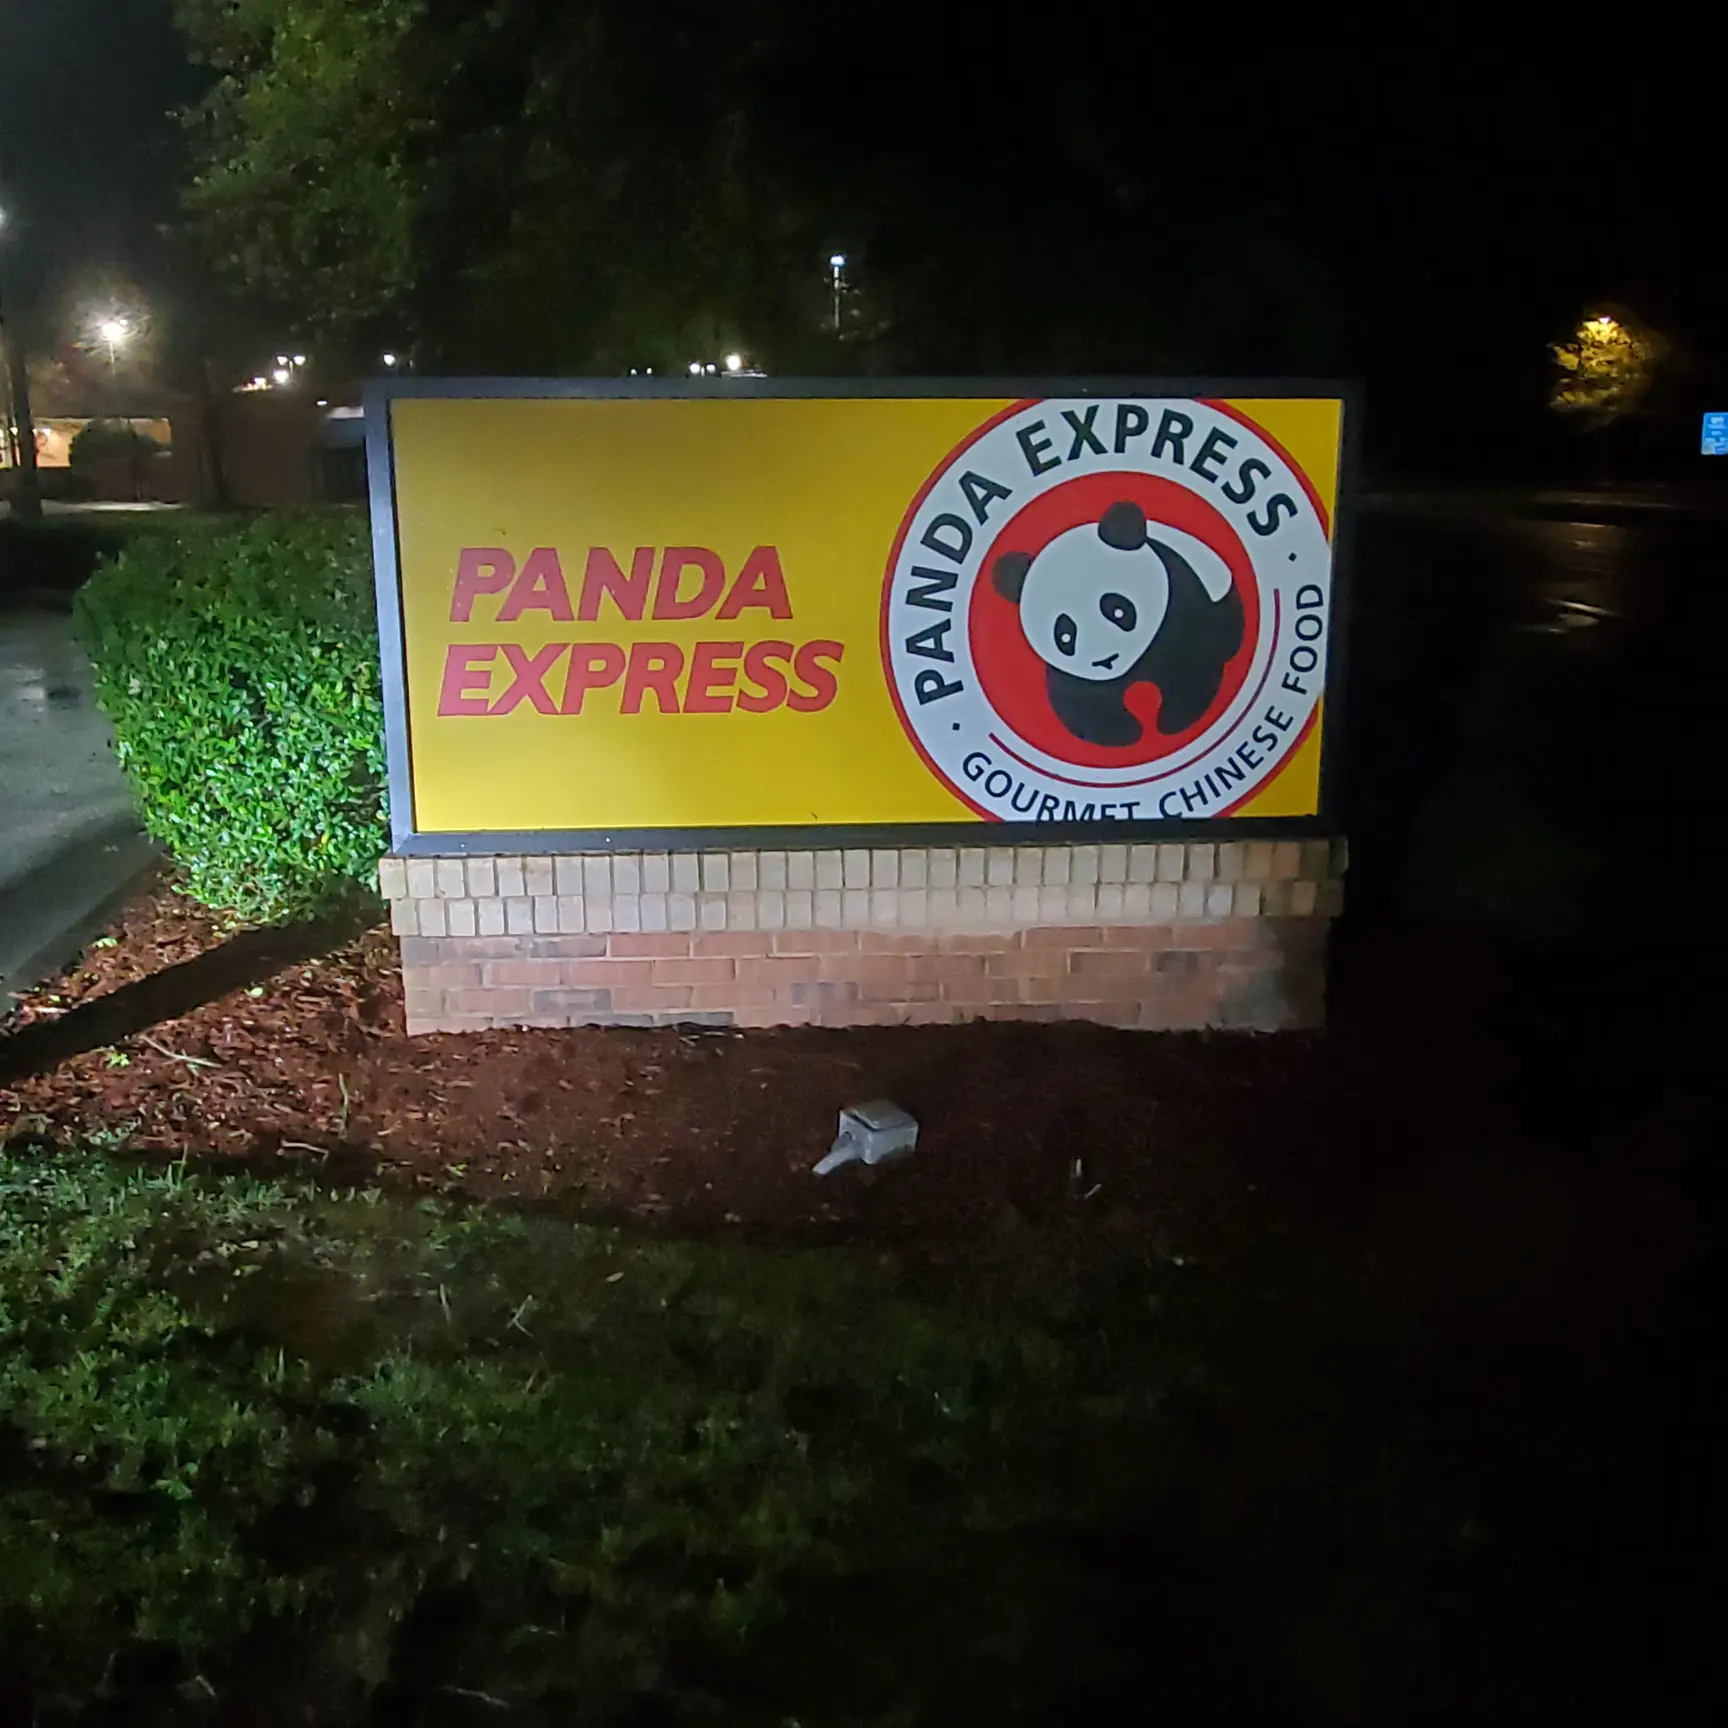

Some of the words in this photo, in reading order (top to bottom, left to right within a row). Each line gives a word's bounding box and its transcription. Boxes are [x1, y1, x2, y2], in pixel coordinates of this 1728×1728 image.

[449, 546, 793, 622] PANDA
[905, 470, 1013, 706] PANDA
[1015, 404, 1298, 536] EXPRESS
[437, 639, 845, 717] EXPRESS
[1158, 705, 1294, 819] CHINESE
[1282, 583, 1324, 695] FOOD
